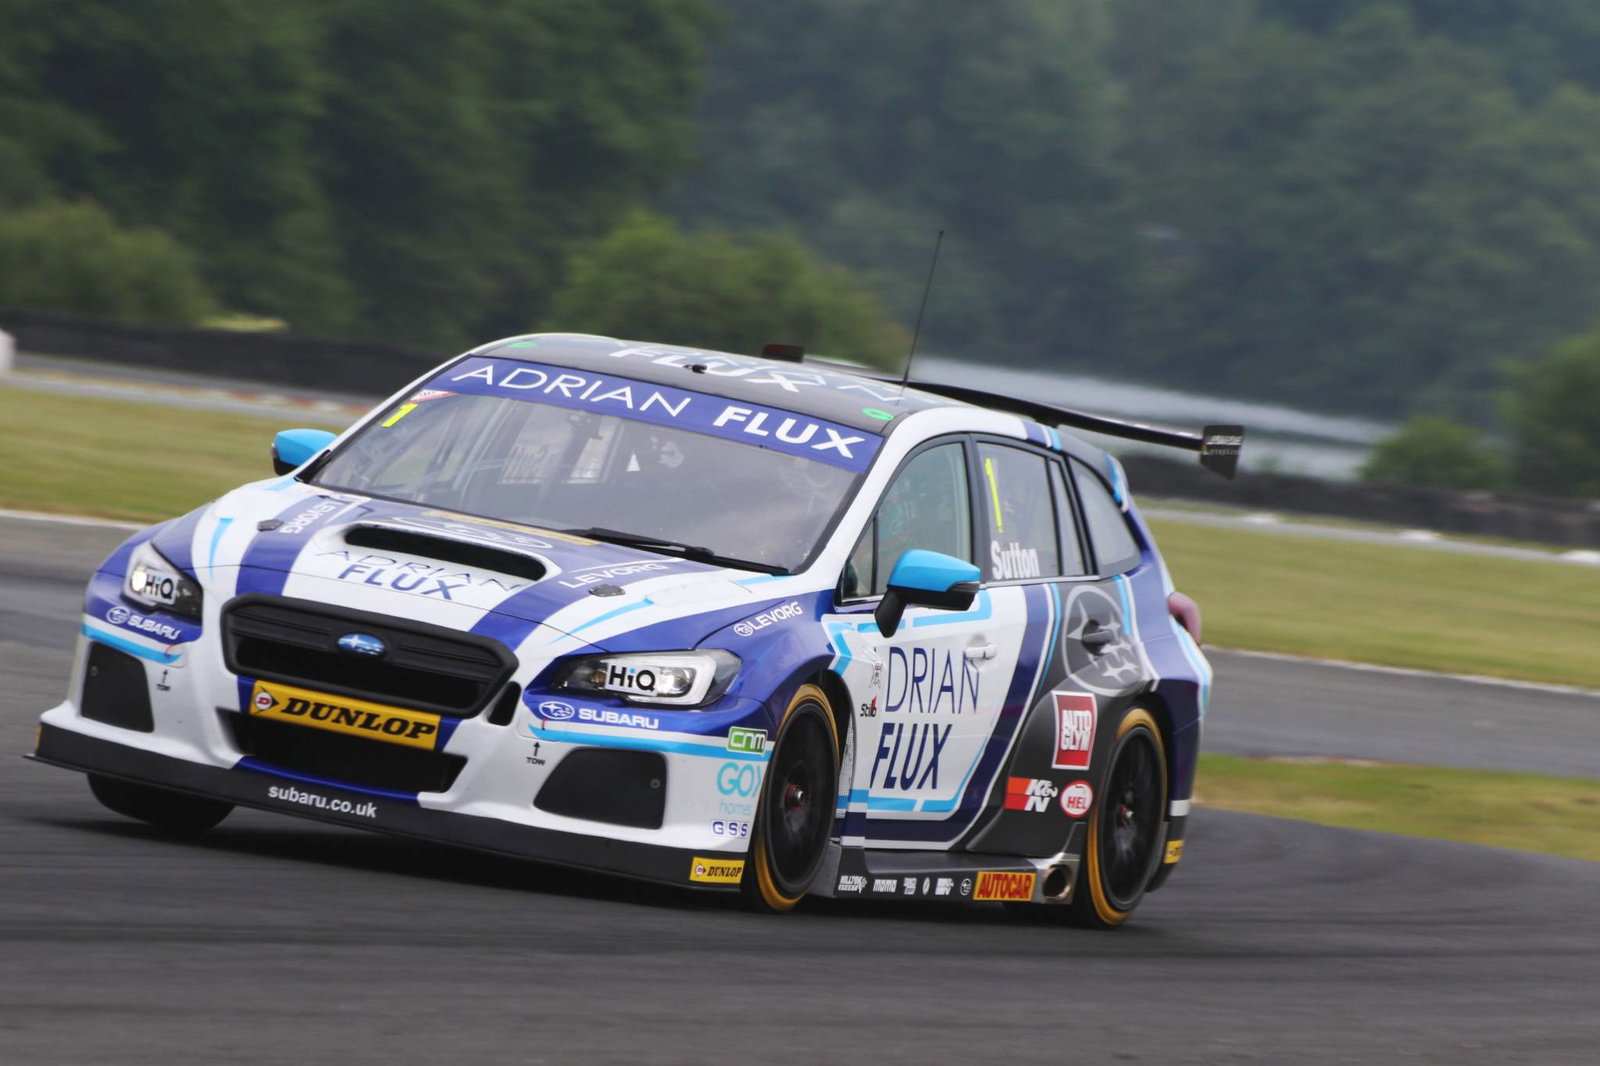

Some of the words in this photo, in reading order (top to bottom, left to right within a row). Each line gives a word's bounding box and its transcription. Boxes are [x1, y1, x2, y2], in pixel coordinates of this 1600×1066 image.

[381, 402, 418, 428] 1
[453, 364, 691, 418] ADRIAN
[713, 405, 866, 459] FLUX
[985, 458, 1004, 533] 1
[316, 551, 521, 592] ADRIAN
[991, 541, 1040, 579] Sutton
[143, 573, 174, 600] HiQ
[338, 564, 467, 600] FLUX
[559, 562, 671, 589] LEVORG
[127, 614, 182, 640] SUBARU
[747, 602, 803, 631] LEVORG
[609, 665, 657, 692] HiQ
[281, 698, 436, 739] DUNLOP
[578, 707, 660, 730] SUBARU
[526, 757, 546, 766] TOW
[869, 722, 953, 791] FLUX
[268, 784, 378, 819] subaru.co.uk
[707, 865, 743, 879] DUNLOP
[976, 873, 1032, 899] AUTOCAR
